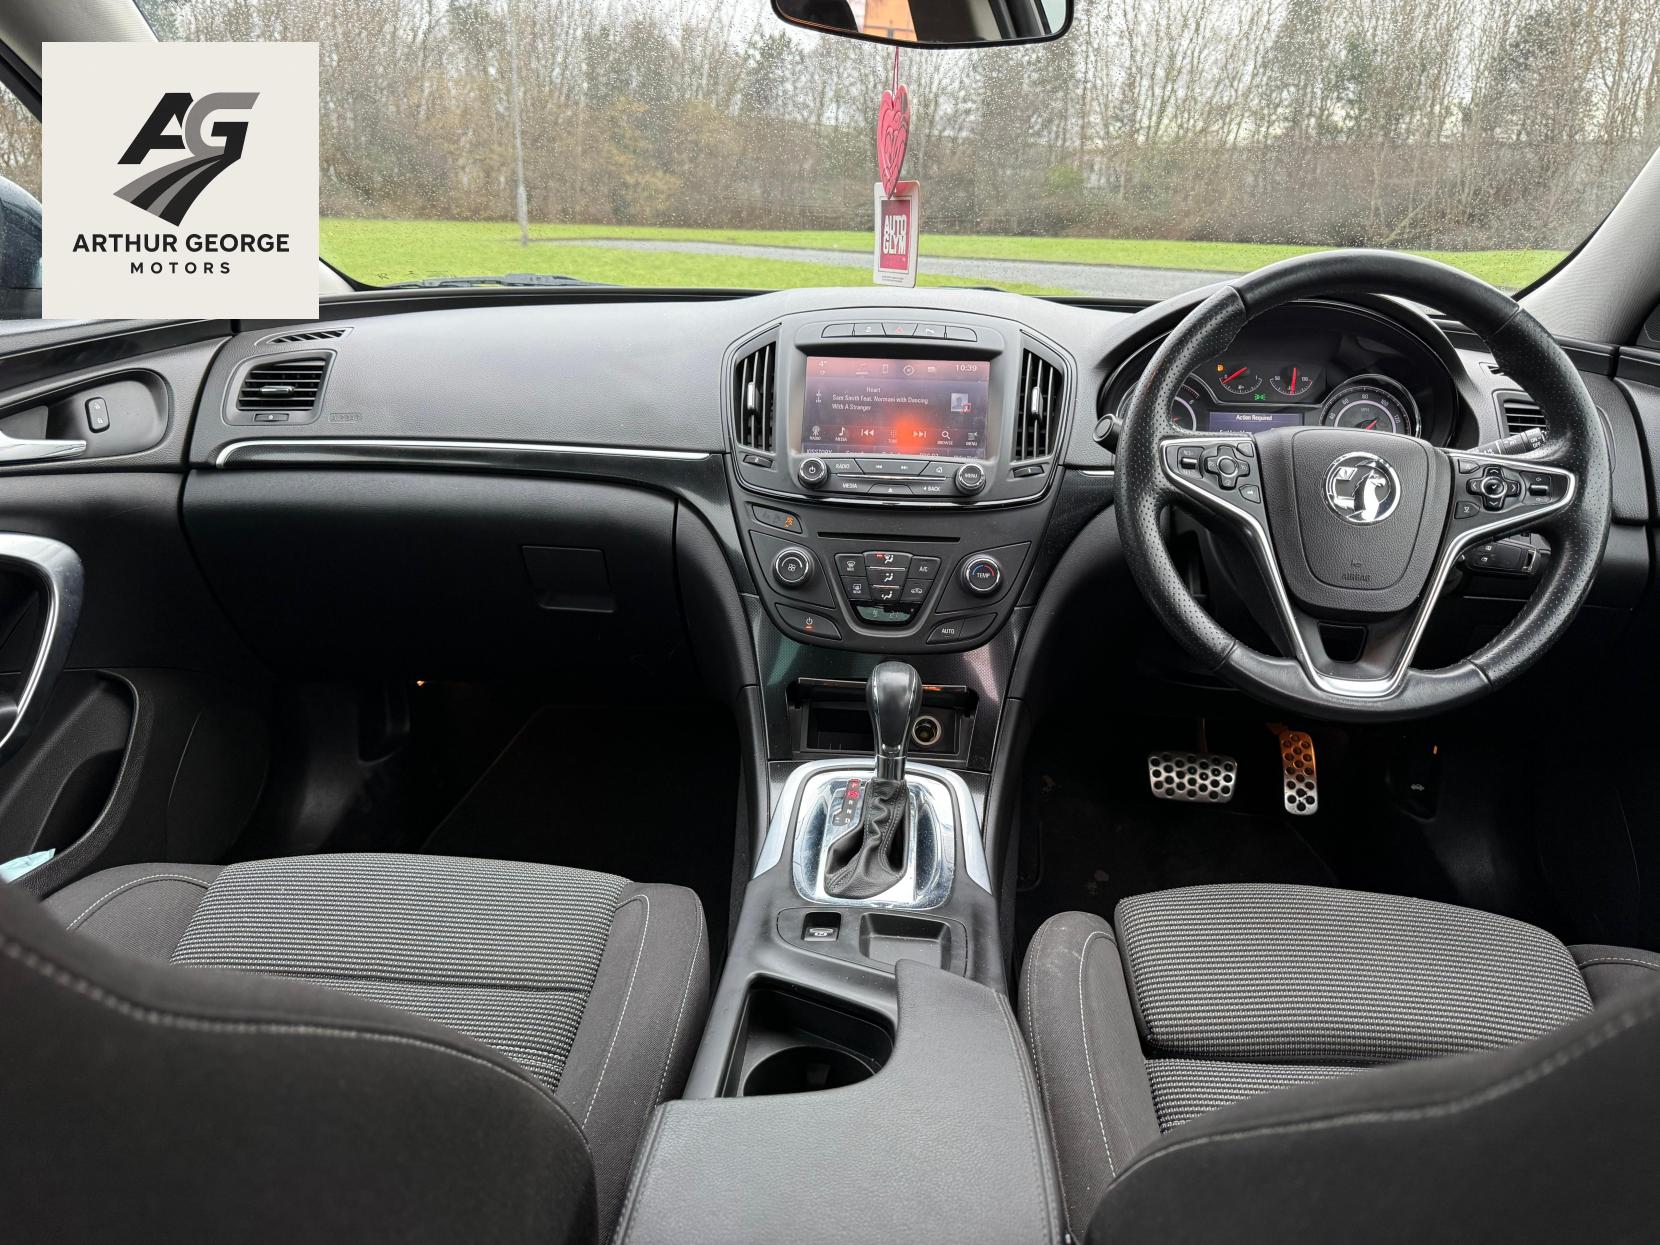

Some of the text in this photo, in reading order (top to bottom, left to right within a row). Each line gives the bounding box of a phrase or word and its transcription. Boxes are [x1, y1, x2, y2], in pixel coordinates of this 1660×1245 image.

[884, 215, 907, 235] AUTO
[883, 233, 906, 255] GLYM
[956, 364, 977, 372] 10:39
[849, 404, 872, 412] Stranger
[1251, 414, 1273, 422] Required
